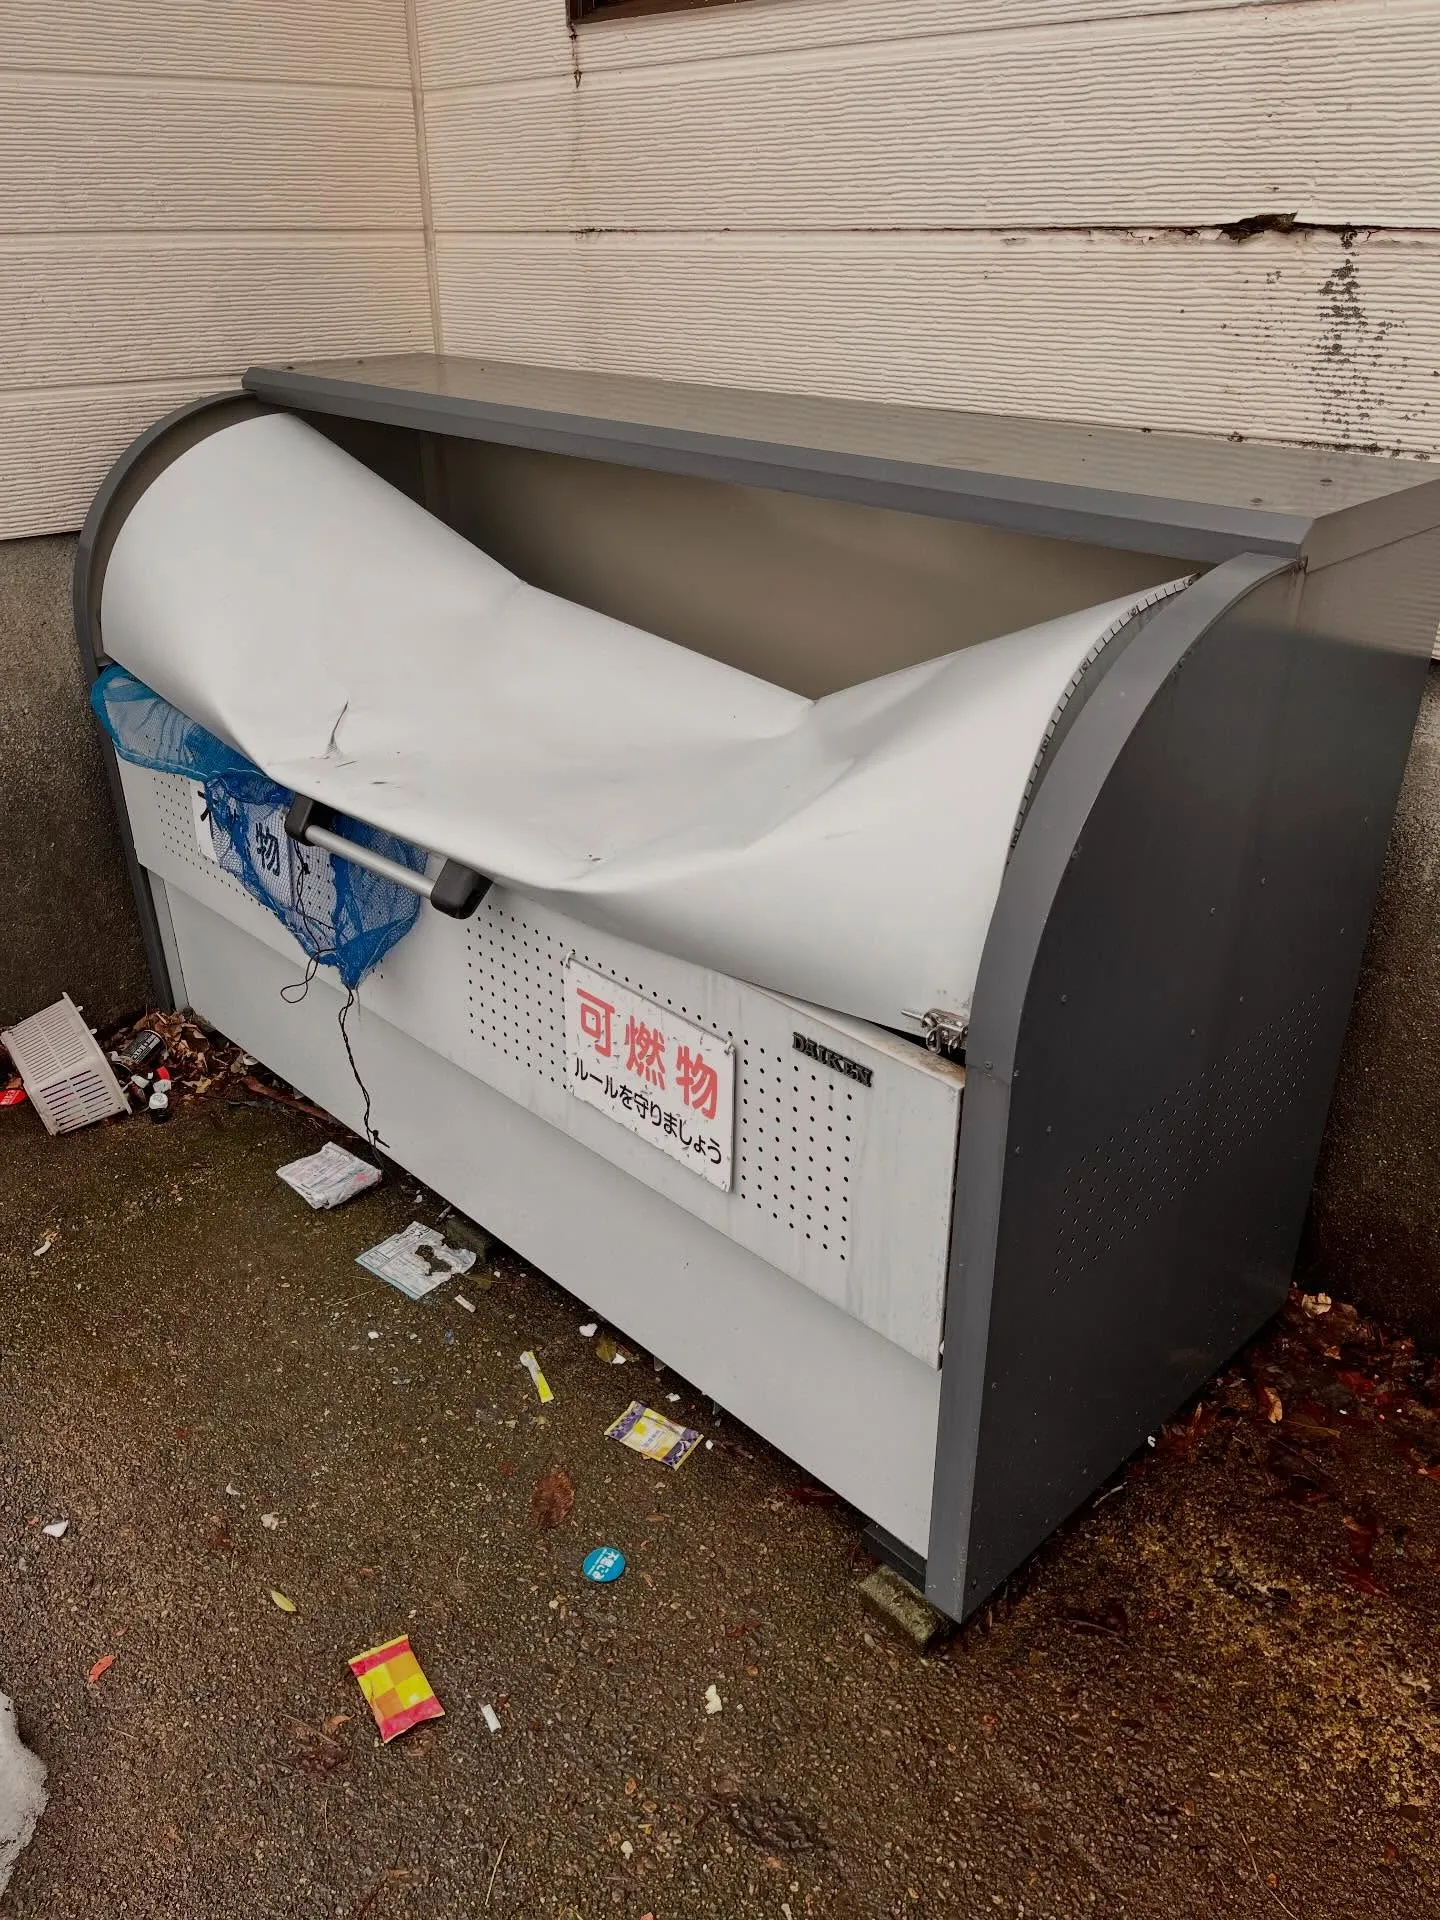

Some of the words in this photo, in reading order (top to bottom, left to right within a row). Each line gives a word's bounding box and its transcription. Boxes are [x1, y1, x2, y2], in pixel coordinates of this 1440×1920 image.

[576, 986, 719, 1121] 可燃物
[791, 1031, 874, 1088] DAIKEN
[574, 1057, 723, 1165] ルールを守りましょう
